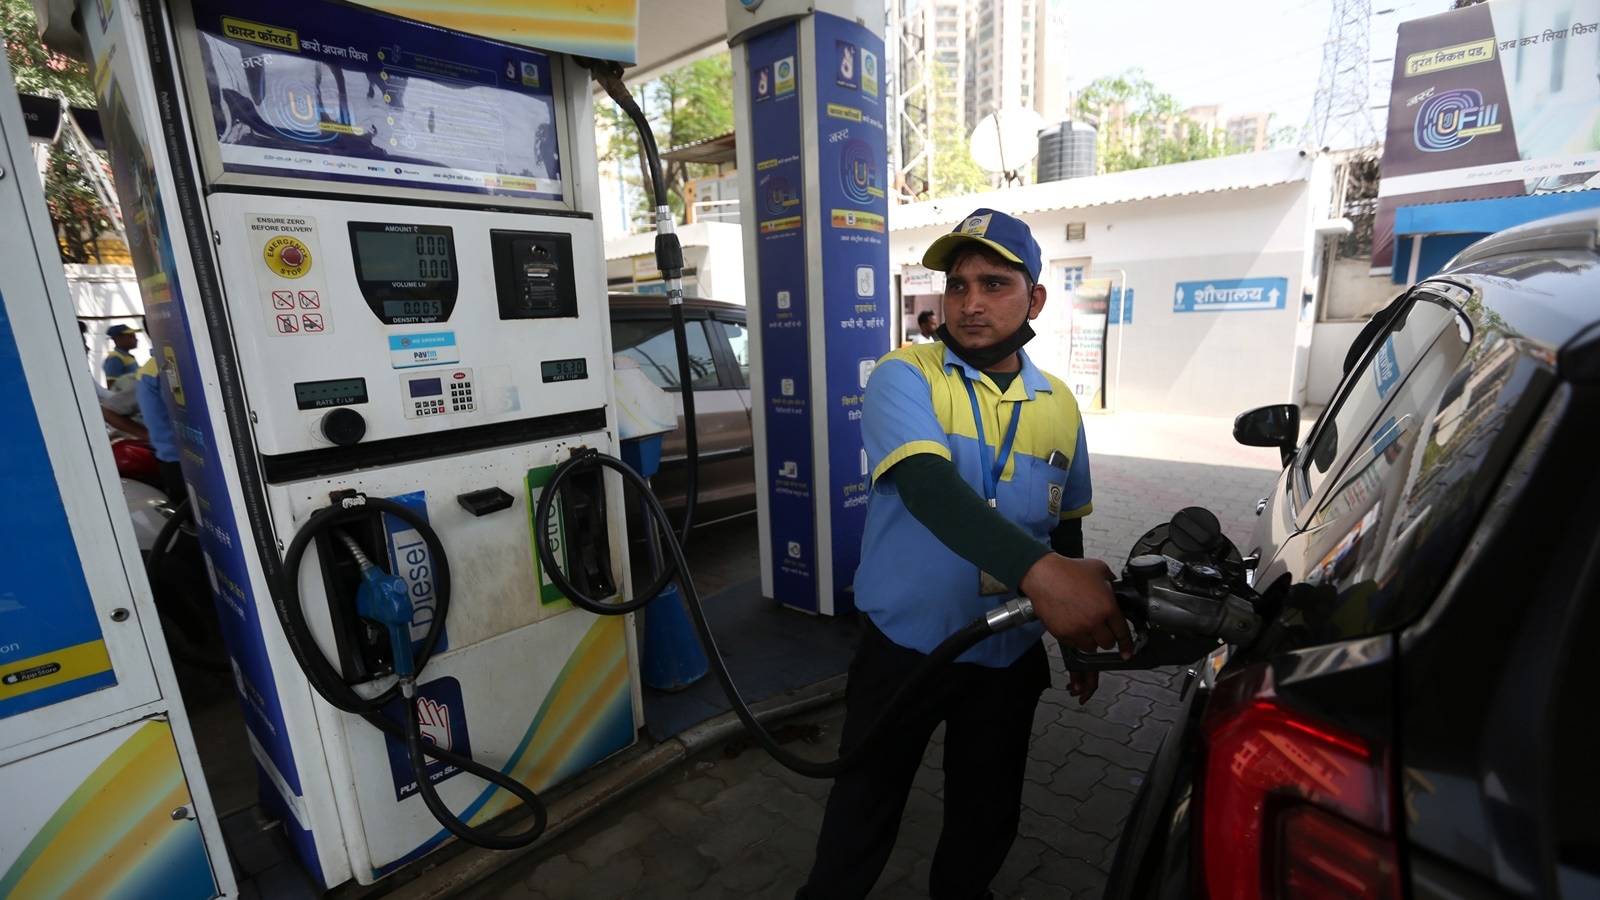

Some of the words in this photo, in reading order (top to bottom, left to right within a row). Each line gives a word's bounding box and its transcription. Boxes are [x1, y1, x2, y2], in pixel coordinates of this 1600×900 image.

[227, 24, 255, 39] फास्ट
[258, 29, 292, 46] फॉरवर्ड
[301, 39, 320, 52] करो
[323, 44, 346, 58] अपना
[349, 47, 368, 62] फिल
[1411, 54, 1432, 73] तुरंत
[1434, 51, 1465, 65] निकल
[1499, 39, 1518, 51] जब
[1519, 34, 1540, 46] कर
[1541, 28, 1568, 42] लिया
[1571, 22, 1599, 37] फिल
[1437, 103, 1498, 134] UFill
[257, 217, 285, 225] ENSURE
[267, 239, 308, 259] EMERGENCY
[416, 235, 446, 256] 0.00
[280, 267, 302, 276] STOP
[419, 259, 449, 279] 0.00
[1194, 284, 1264, 303] शौचालय
[398, 541, 435, 628] Diesel
[22, 672, 37, 680] App
[38, 667, 57, 676] Store
